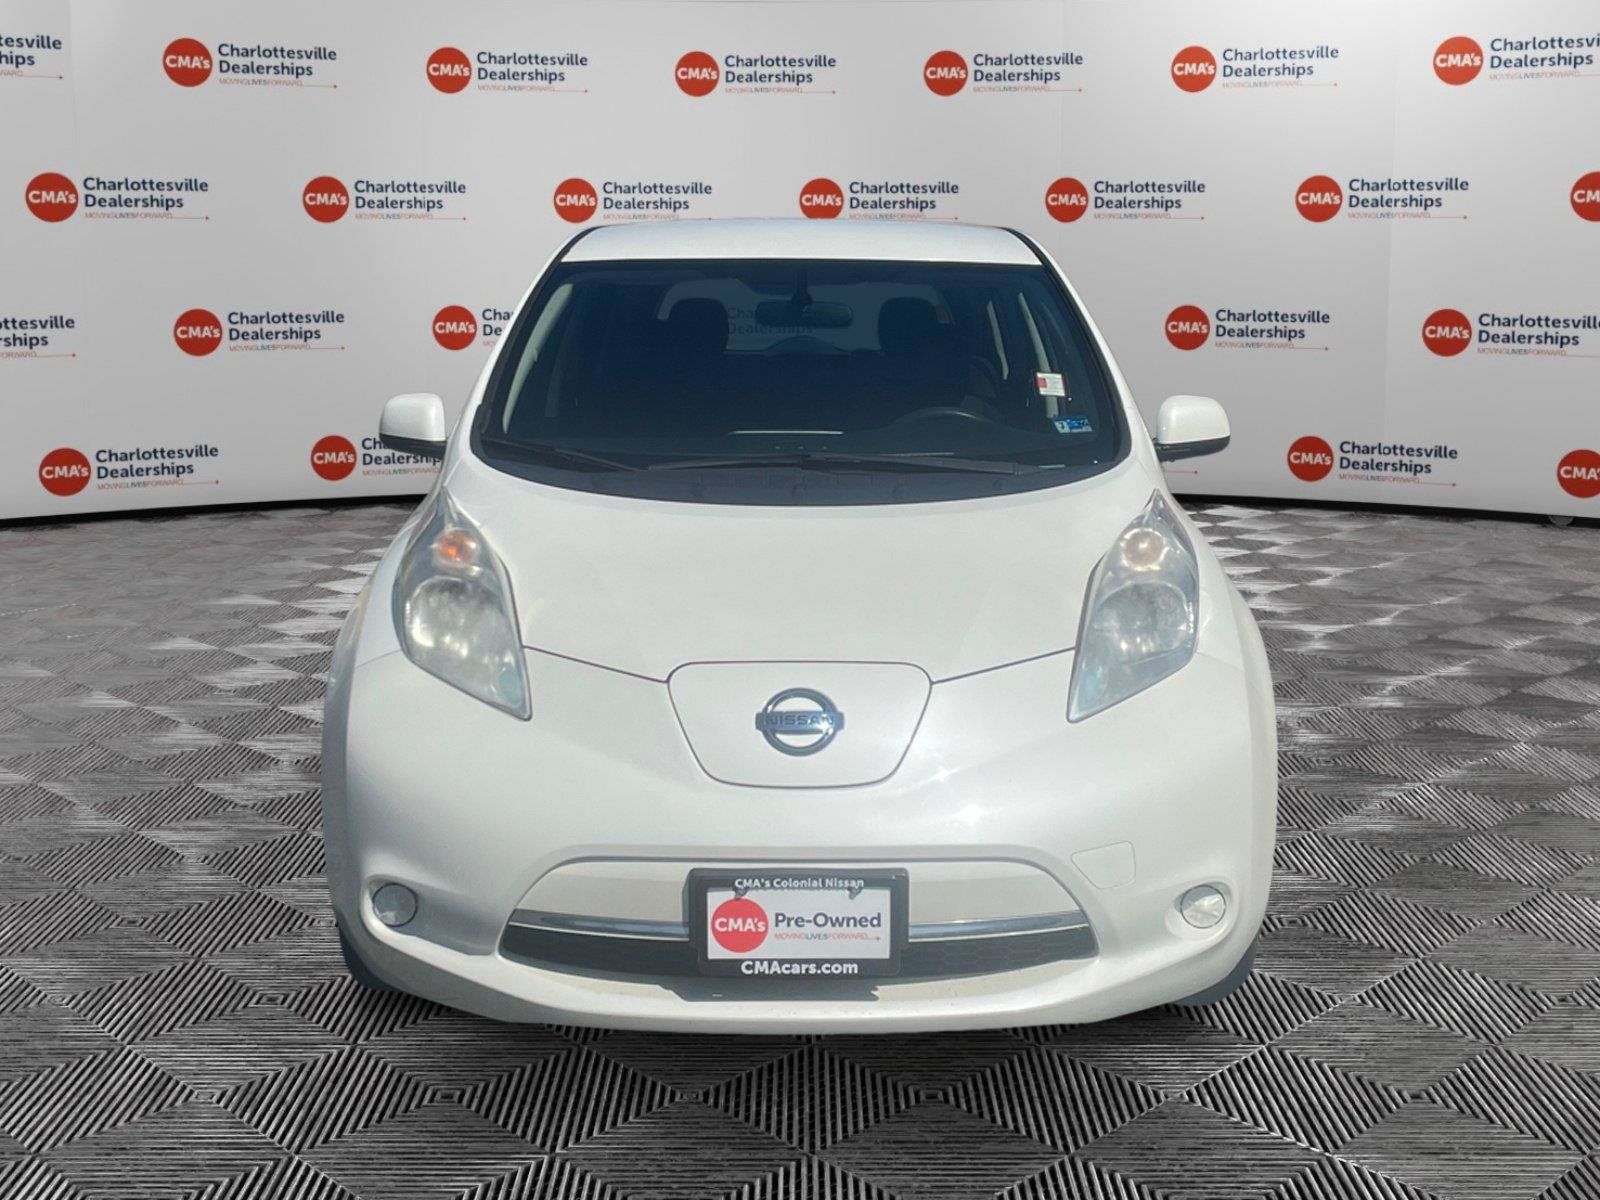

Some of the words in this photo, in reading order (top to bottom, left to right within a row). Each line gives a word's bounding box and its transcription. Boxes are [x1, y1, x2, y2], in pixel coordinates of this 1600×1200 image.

[218, 43, 337, 61] Charlottesville
[476, 51, 588, 66] Charlottesville
[973, 52, 1083, 67] Charlottesville
[1222, 46, 1339, 62] Charlottesville
[165, 55, 211, 70] CMA's
[724, 54, 837, 68] Charlottesville
[1434, 52, 1483, 68] CMA's
[1490, 52, 1594, 69] Dealerships
[218, 59, 313, 78] Dealerships
[428, 63, 471, 77] CMA's
[477, 67, 566, 85] Dealerships
[677, 67, 719, 80] CMA's
[926, 66, 967, 79] CMA's
[1173, 62, 1216, 77] CMA's
[1222, 63, 1314, 79] Dealerships
[725, 70, 813, 86] Dealerships
[973, 68, 1061, 85] Dealerships
[82, 177, 209, 192] Charlottesville
[354, 179, 466, 194] Charlottesville
[602, 181, 712, 195] Charlottesville
[849, 181, 959, 194] Charlottesville
[1094, 180, 1206, 194] Charlottesville
[1348, 177, 1469, 192] Charlottesville
[28, 190, 77, 204] CMA's
[84, 193, 184, 211] Dealerships
[304, 192, 348, 206] CMA's
[355, 195, 444, 213] Dealerships
[555, 194, 596, 207] CMA's
[603, 196, 690, 213] Dealerships
[801, 193, 842, 206] CMA's
[849, 196, 937, 213] Dealerships
[1047, 193, 1087, 206] CMA's
[1094, 196, 1182, 212] Dealerships
[1297, 192, 1341, 205] CMA's
[1348, 194, 1442, 211] Dealerships
[227, 310, 345, 325] Charlottesville
[1215, 309, 1330, 324] Charlottesville
[1478, 313, 1600, 330] Charlottesvill
[175, 325, 221, 339] CMA's
[228, 326, 322, 343] Dealerships
[434, 321, 476, 334] CMA's
[1167, 321, 1209, 334] CMA's
[1215, 324, 1306, 342] Dealerships
[1424, 325, 1471, 339] CMA's
[1478, 329, 1580, 349] Dealerships
[95, 445, 219, 463] Charlottesville
[313, 451, 355, 465] CMA's
[1339, 441, 1458, 460] Charlottesville
[1289, 452, 1332, 466] CMA's
[1339, 456, 1432, 475] Dealerships
[41, 465, 89, 479] CMA's
[96, 462, 194, 480] Dealerships
[734, 878, 771, 888] CMA's
[774, 878, 823, 888] Colonial
[825, 878, 864, 888] Nissan
[714, 918, 767, 933] CMA's
[774, 912, 882, 929] Pre-Owned
[740, 960, 859, 976] CMAcars.com
